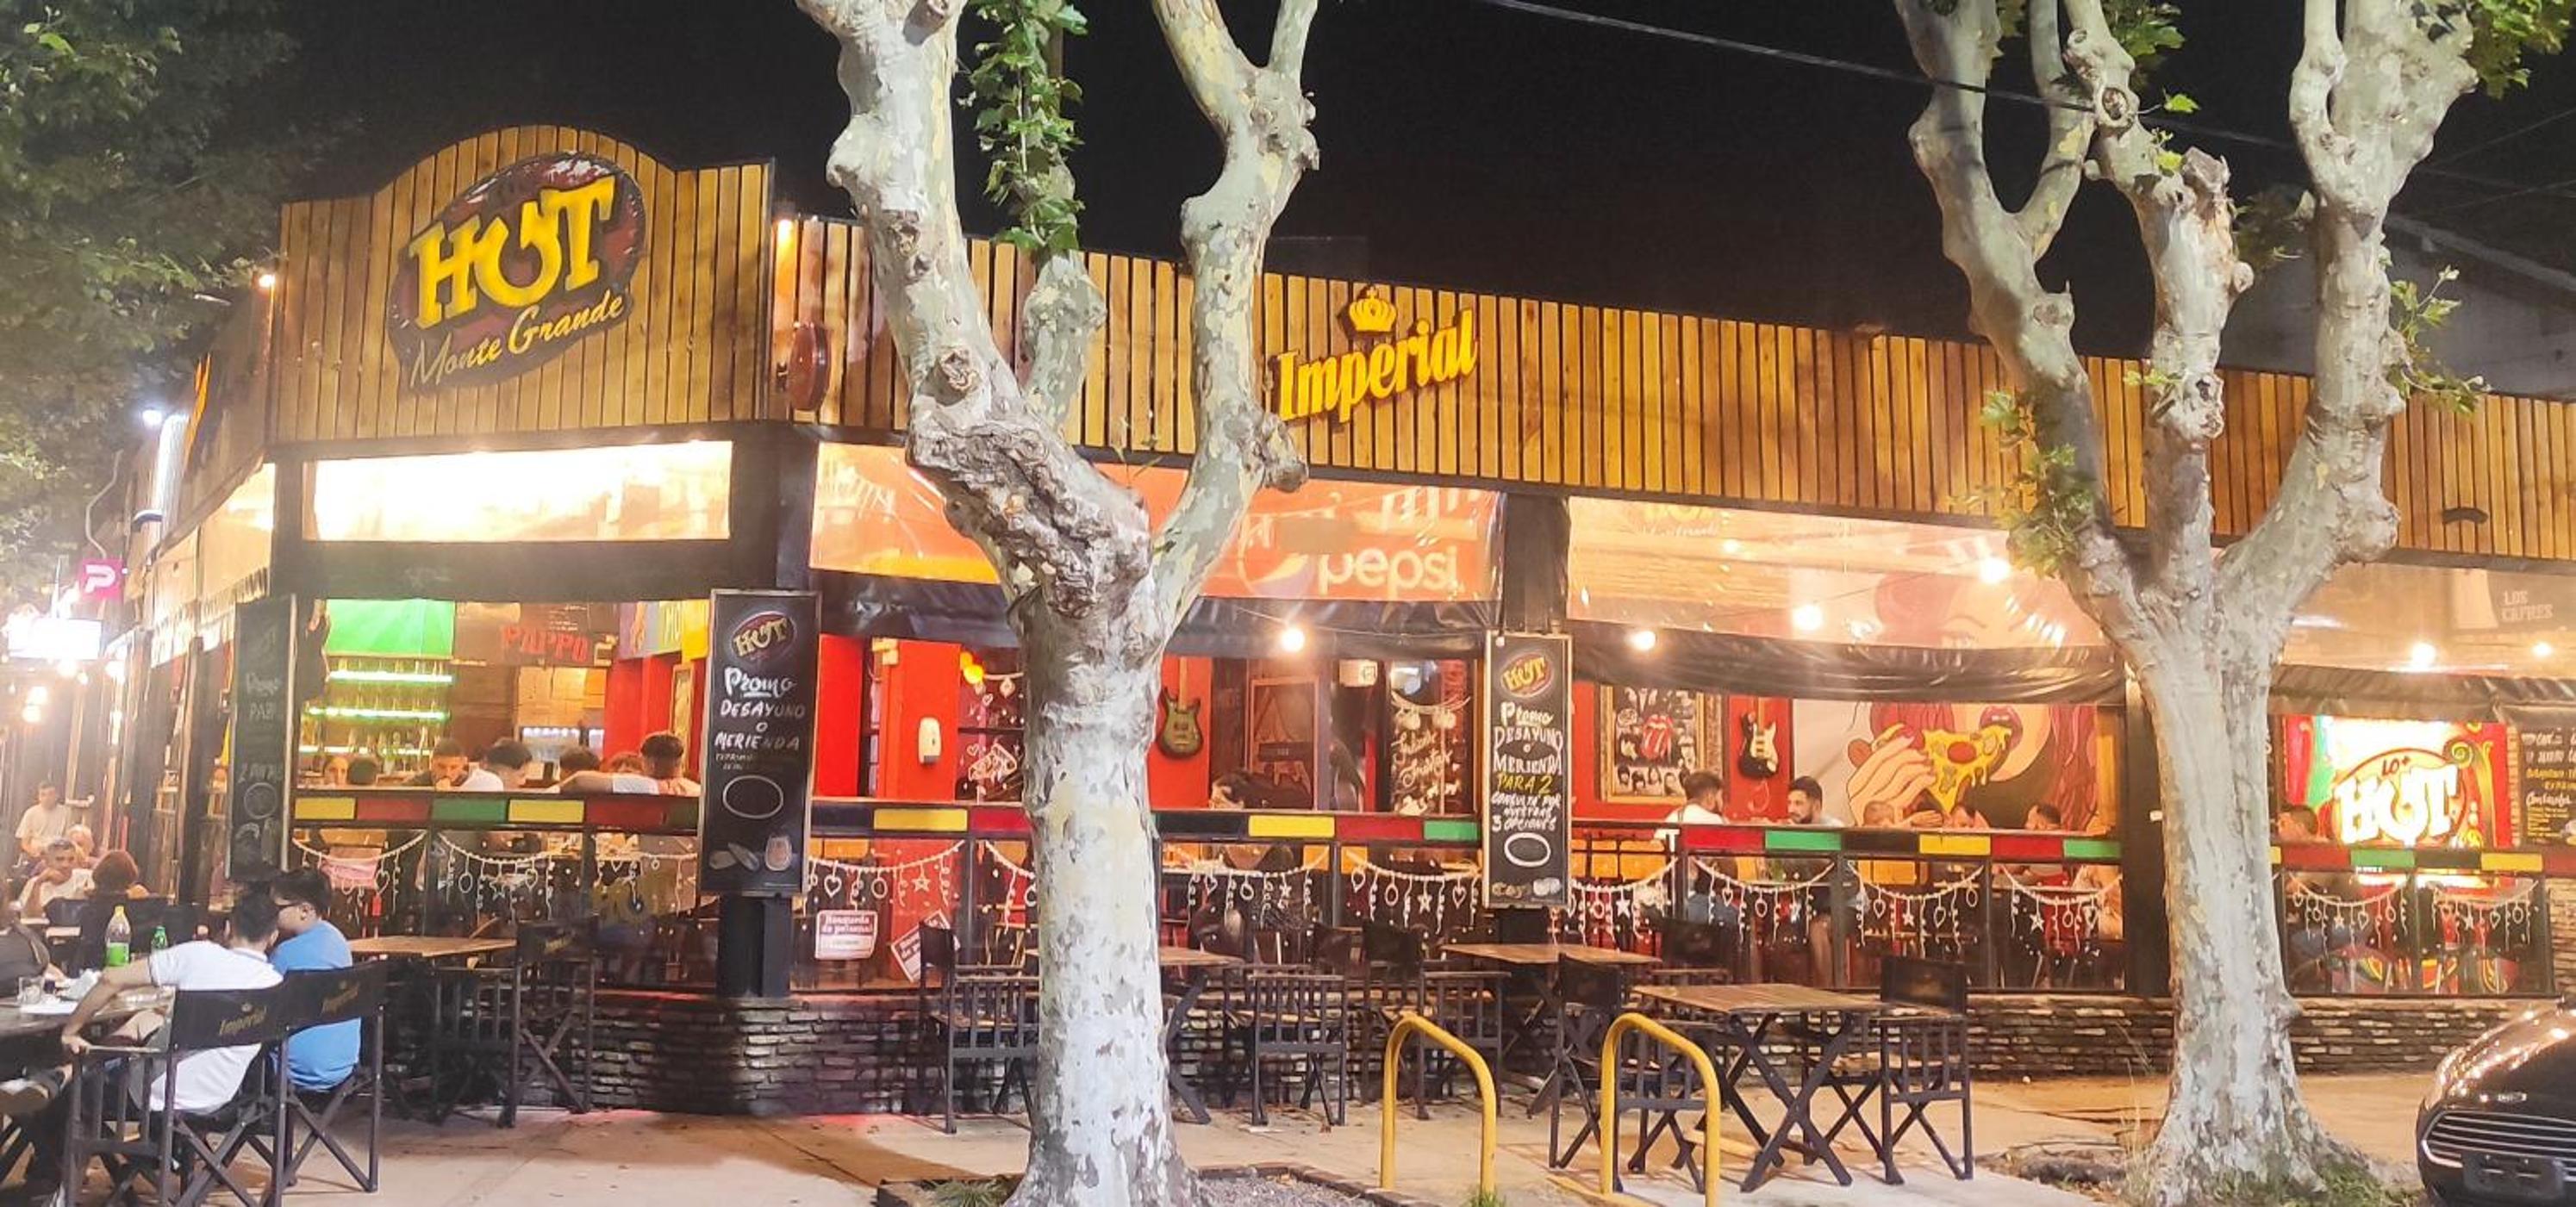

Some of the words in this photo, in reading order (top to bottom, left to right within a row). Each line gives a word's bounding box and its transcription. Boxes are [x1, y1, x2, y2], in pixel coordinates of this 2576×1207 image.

[410, 332, 502, 387] Monte
[508, 289, 625, 354] Grande
[1278, 308, 1477, 423] Imperial
[1318, 545, 1458, 600] pepsi
[720, 700, 805, 719] DESAYUNO
[714, 733, 800, 750] MERIENDA
[1494, 726, 1562, 752] DESAYUNO
[1494, 750, 1562, 775] MERIENDA
[1497, 774, 1536, 793] PARA
[1538, 775, 1553, 798] 2
[1492, 815, 1501, 832] 3
